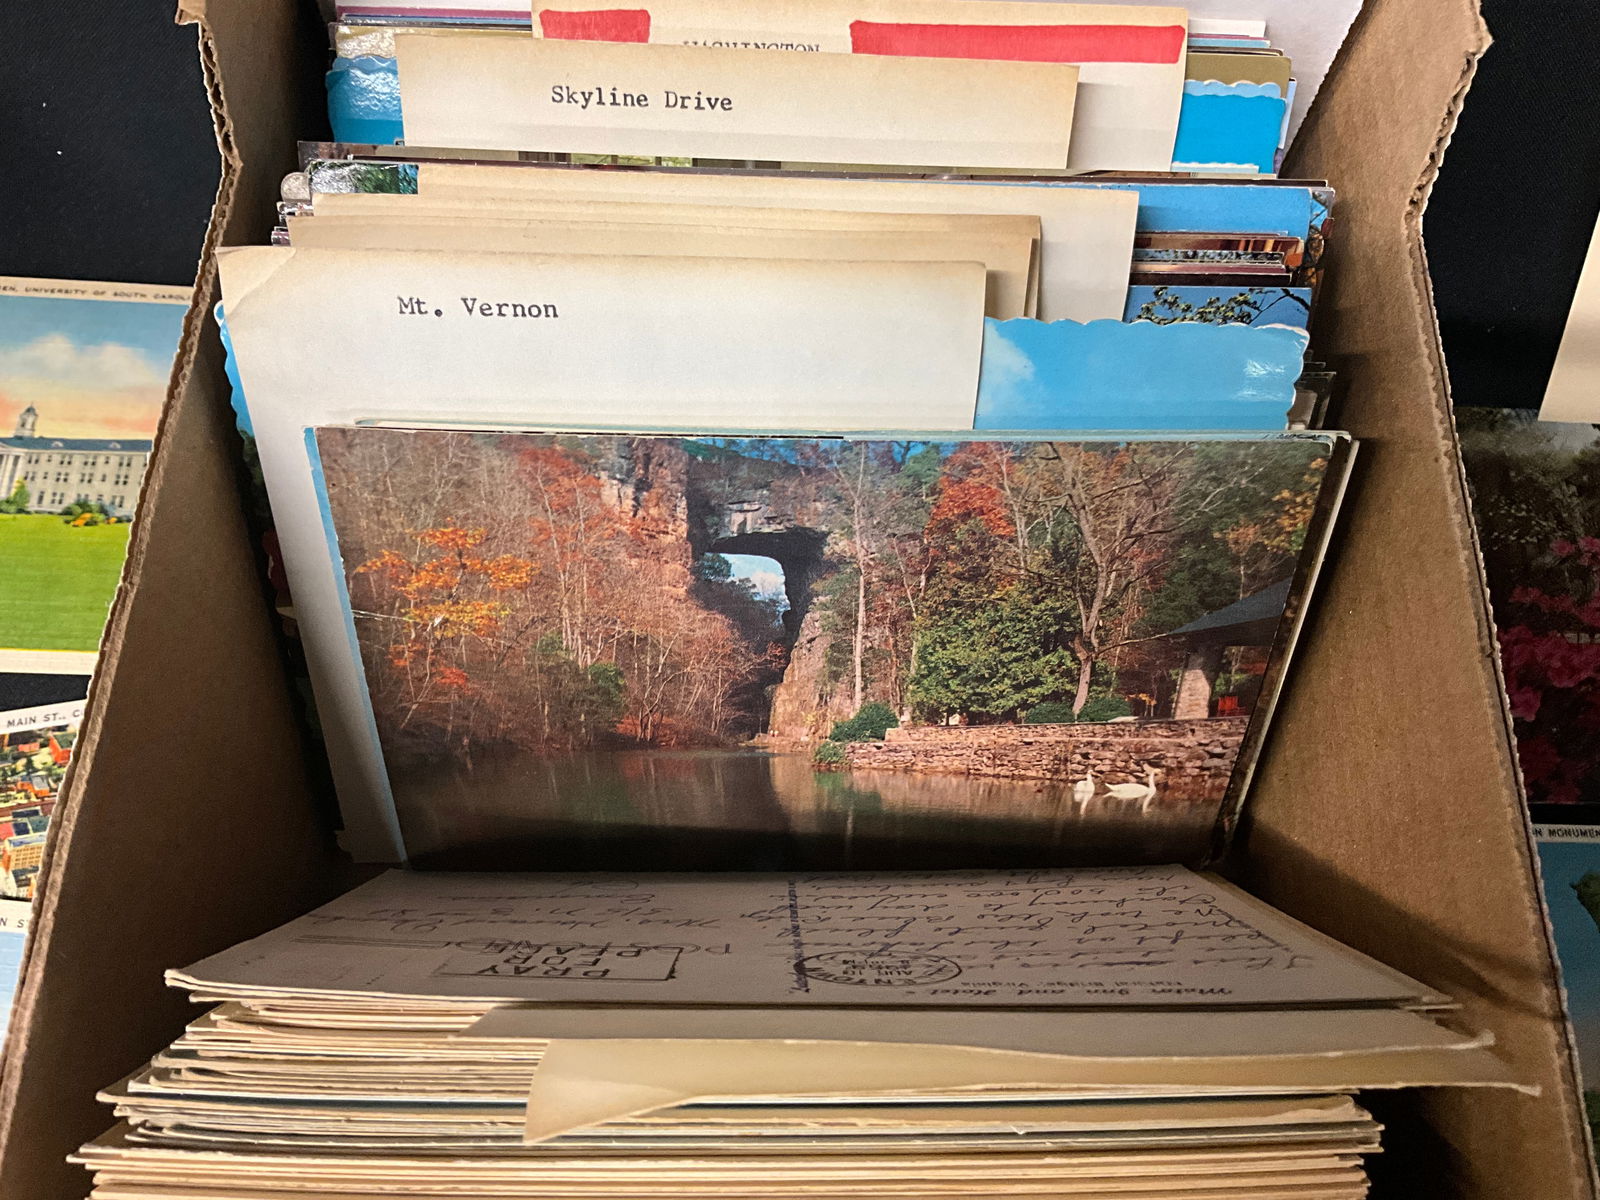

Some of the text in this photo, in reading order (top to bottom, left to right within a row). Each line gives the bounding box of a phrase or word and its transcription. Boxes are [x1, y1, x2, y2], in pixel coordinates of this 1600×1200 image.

[551, 85, 733, 111] Skyline Drive
[25, 286, 88, 295] UNIVERSITY
[113, 291, 147, 299] SOUTH
[397, 296, 559, 318] Mt. Vernon
[7, 716, 37, 728] MAIN
[482, 944, 641, 957] PEACE
[503, 955, 602, 966] FOR
[477, 965, 611, 978] PRAY
